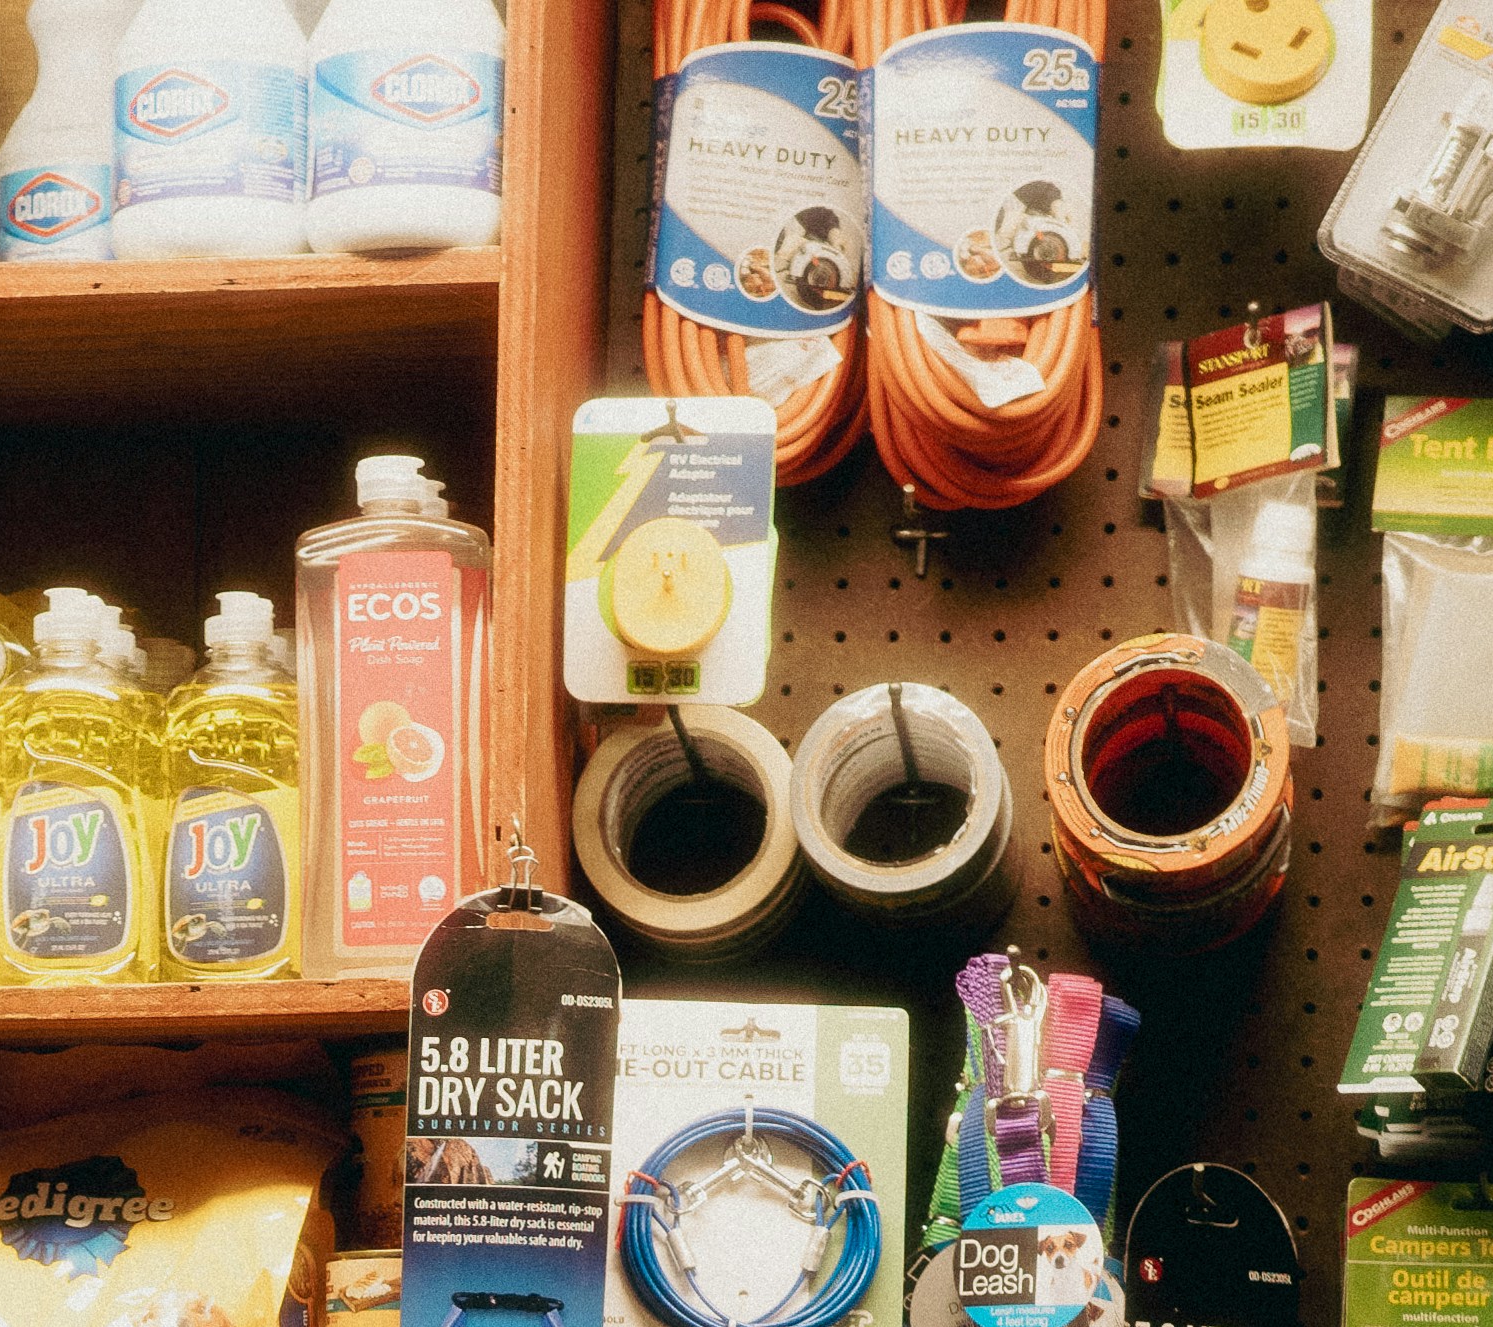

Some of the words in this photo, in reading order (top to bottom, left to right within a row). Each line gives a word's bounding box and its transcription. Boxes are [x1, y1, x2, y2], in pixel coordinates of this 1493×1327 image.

[135, 82, 220, 124] CLOROX
[894, 126, 975, 147] HEAVY
[985, 126, 1052, 145] DUTY
[687, 135, 770, 163] HEAVY
[775, 147, 839, 171] DUTY
[14, 187, 90, 223] CLOROX
[1194, 386, 1236, 412] Seam
[1238, 372, 1286, 399] Sealer
[1410, 432, 1480, 462] Tent
[347, 592, 443, 623] ECOS
[362, 794, 431, 806] GRAPEFRUIT
[36, 875, 98, 889] ULTRA
[195, 877, 253, 892] ULTRA
[420, 1036, 470, 1074] 5.8
[479, 1037, 565, 1077] LITER
[417, 1076, 487, 1117] DRY
[494, 1078, 584, 1122] SACK
[416, 1118, 521, 1133] SURVIVOR
[535, 1121, 608, 1137] SERIES
[1406, 1225, 1489, 1238] Multi-Function
[958, 1238, 1020, 1275] Dog
[1369, 1235, 1472, 1261] Campers
[958, 1267, 1035, 1297] Leash
[1392, 1269, 1450, 1290] Outil
[1457, 1270, 1487, 1290] de
[1387, 1287, 1491, 1311] campeur
[1401, 1311, 1480, 1325] multifonction
